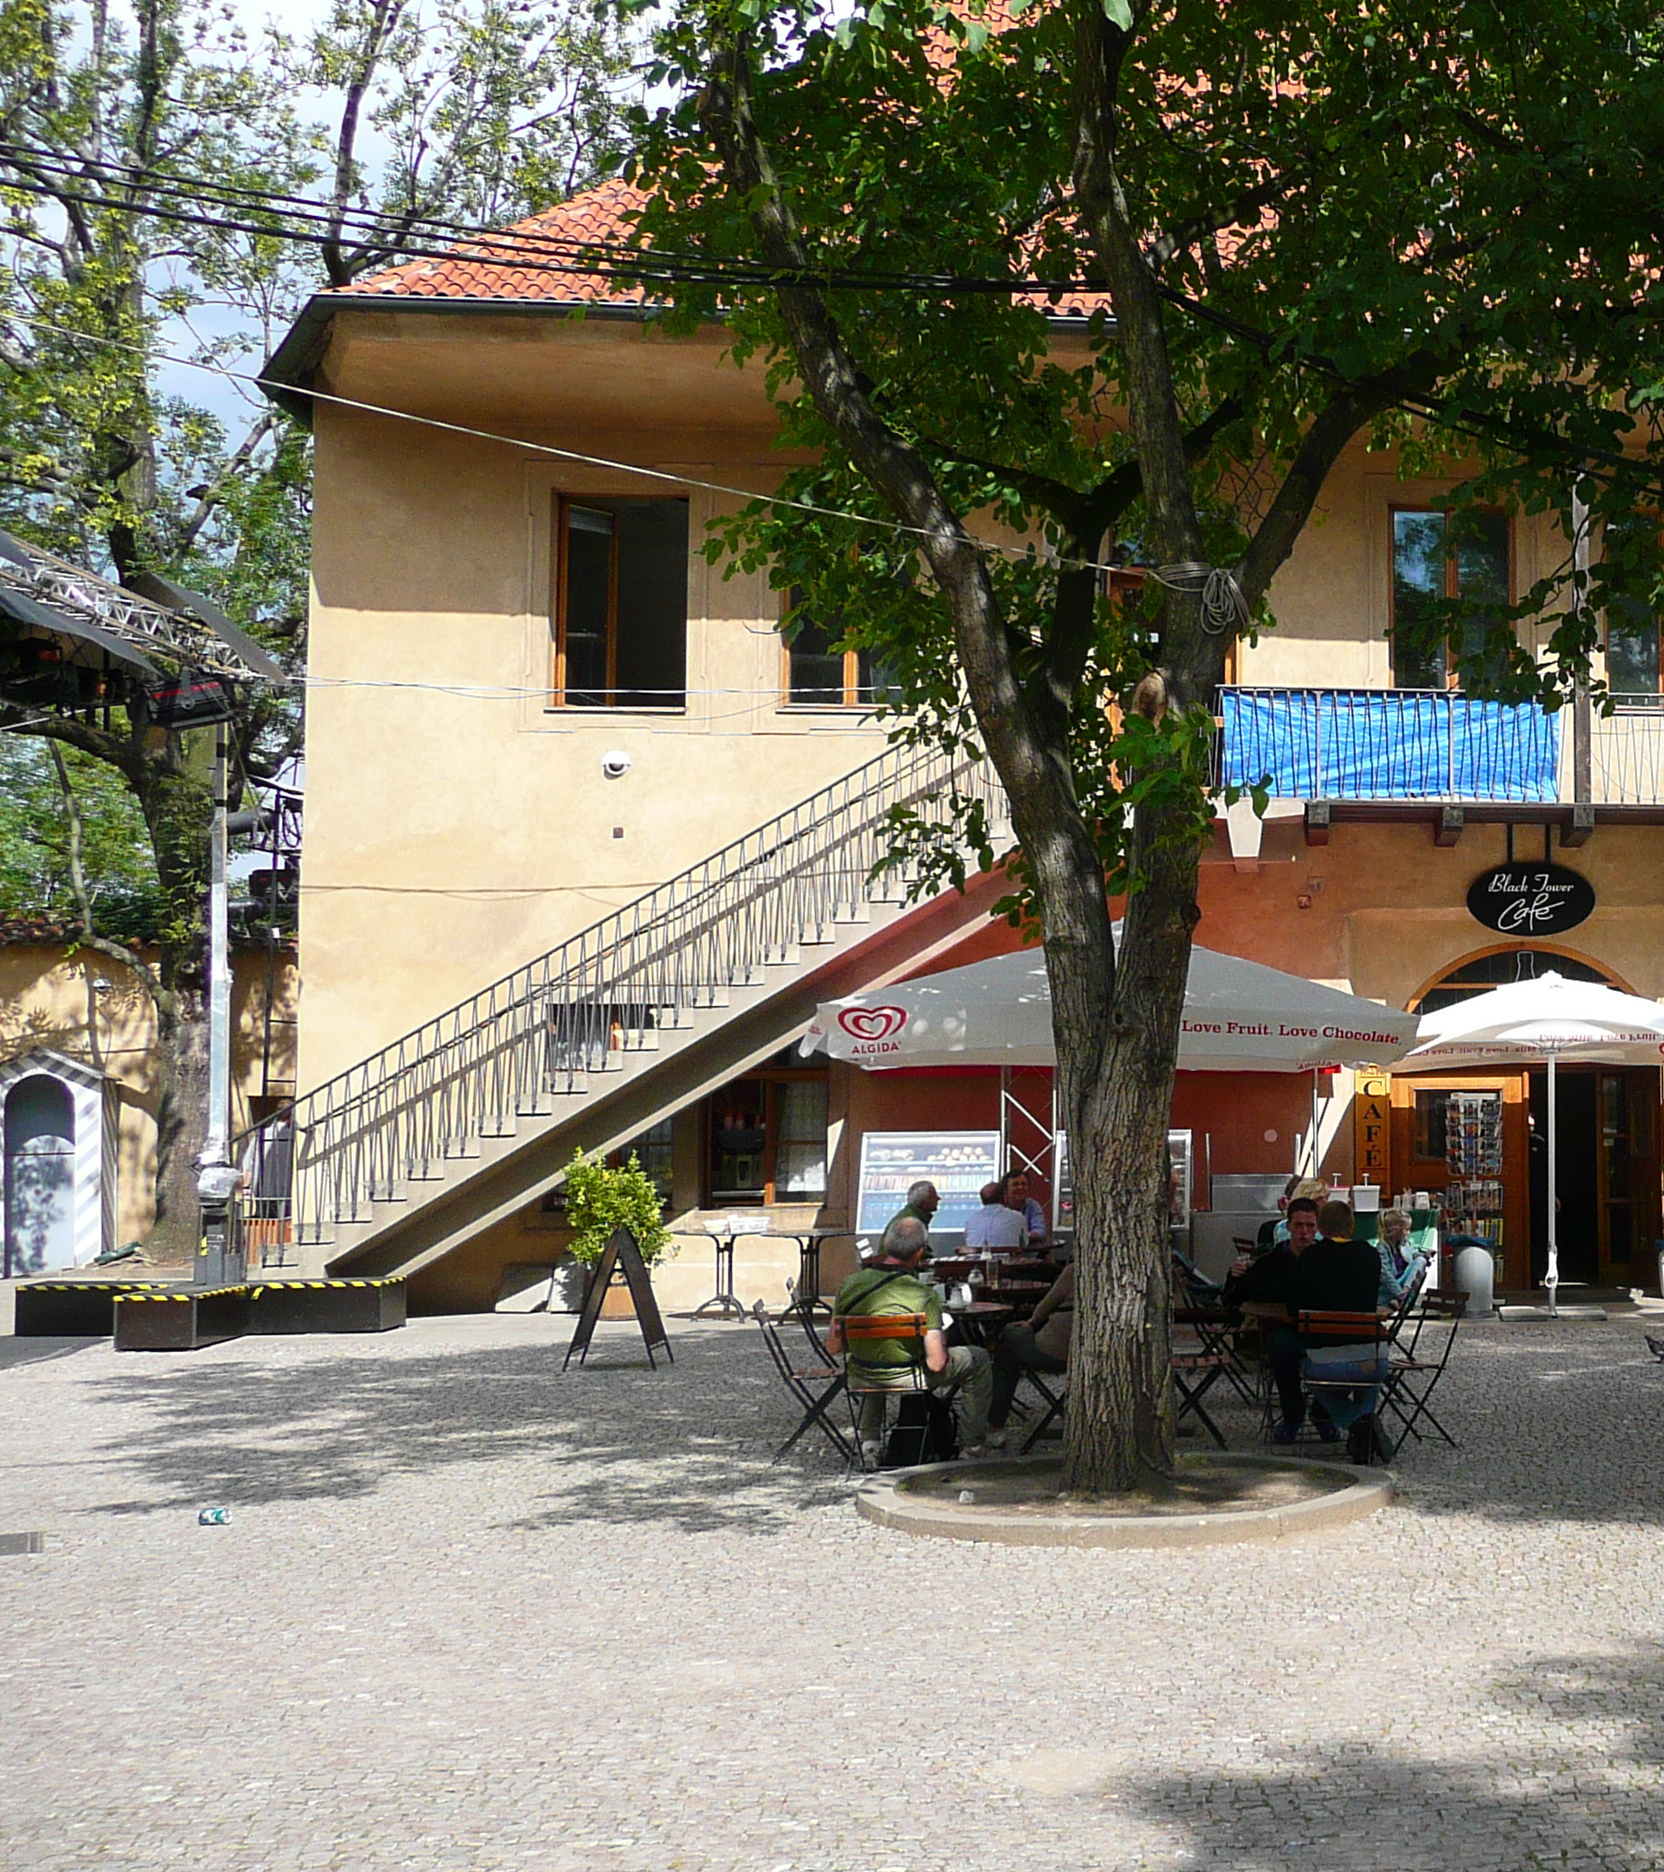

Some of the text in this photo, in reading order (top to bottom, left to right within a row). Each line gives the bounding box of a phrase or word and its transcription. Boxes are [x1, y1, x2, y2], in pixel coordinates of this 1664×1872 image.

[1488, 873, 1575, 892] Black Tower
[1182, 1019, 1222, 1034] Love
[1278, 1024, 1318, 1038] Love
[852, 1042, 900, 1054] ALGIDA
[1363, 1080, 1383, 1167] CAFÉ
